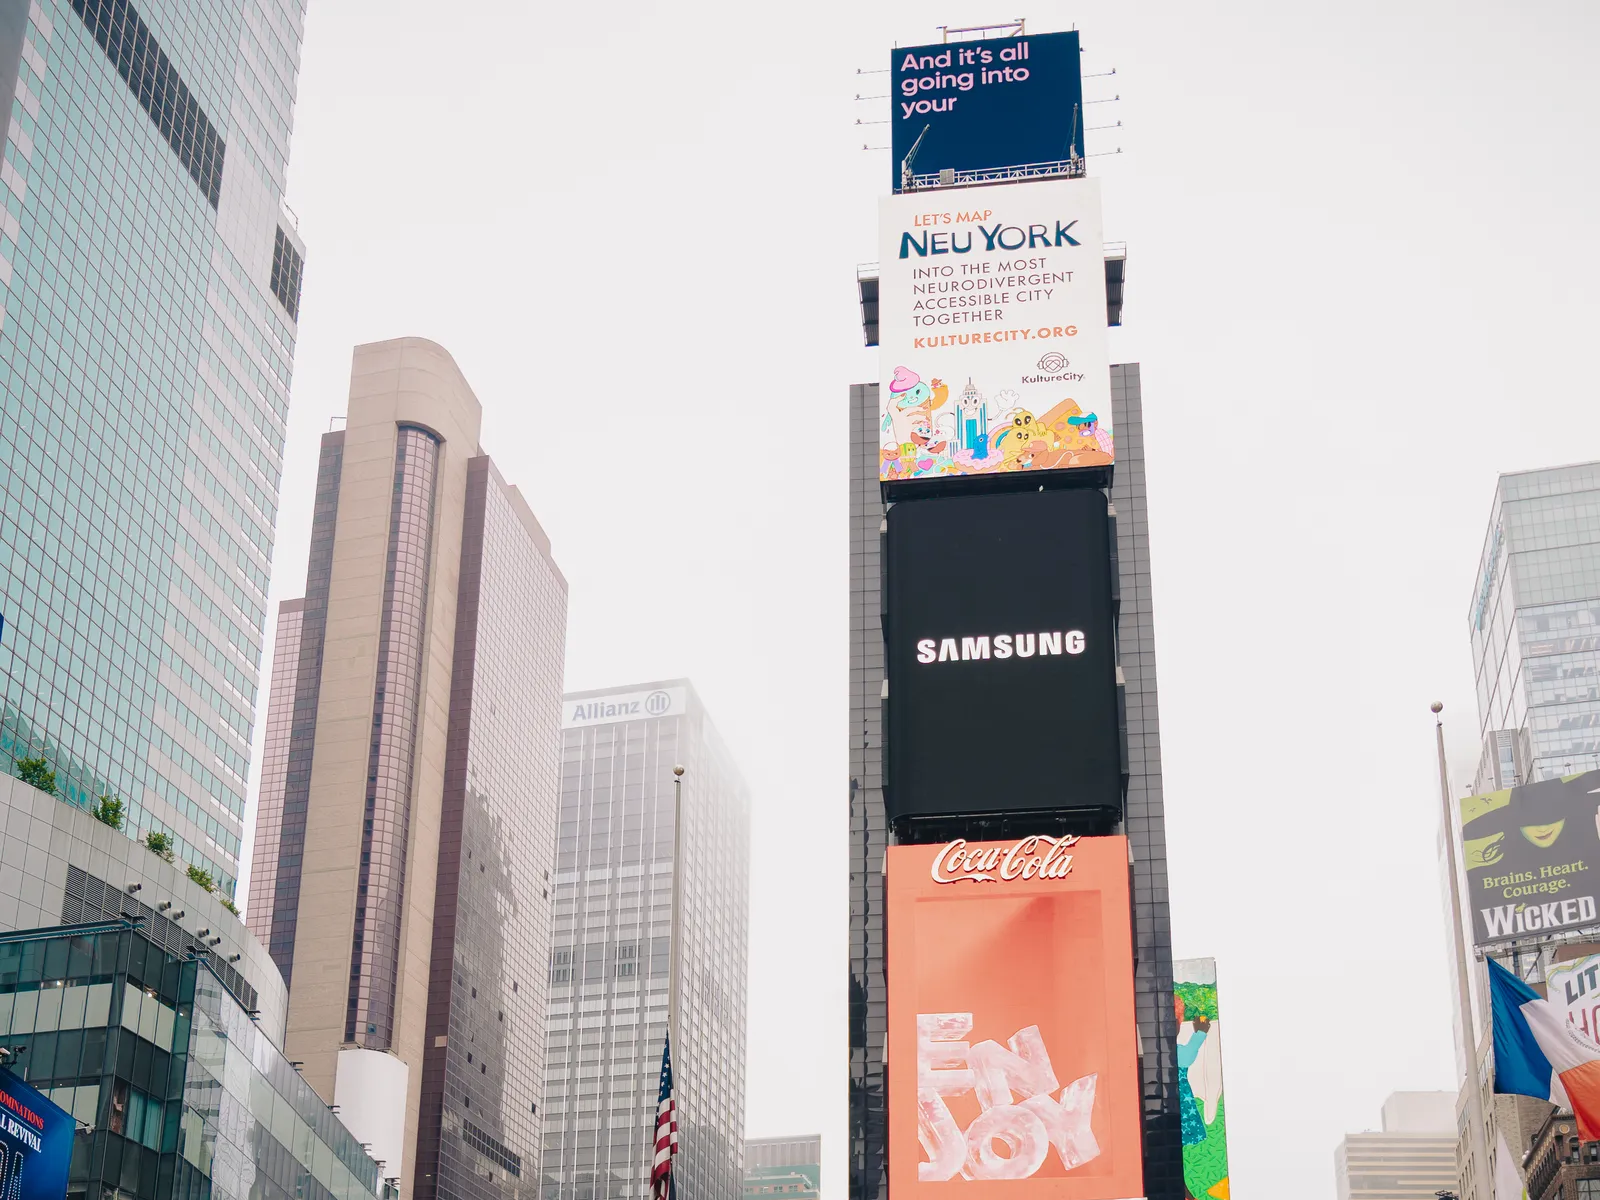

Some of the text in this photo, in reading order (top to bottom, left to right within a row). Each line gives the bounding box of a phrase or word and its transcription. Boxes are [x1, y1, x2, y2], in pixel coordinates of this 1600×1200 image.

[900, 42, 1029, 72] And it's all
[900, 65, 1030, 96] going into
[900, 96, 957, 119] your
[914, 210, 992, 227] LET'S MAP
[913, 258, 1047, 279] INTO THE MOST
[913, 271, 1074, 295] NEURODIVERGENT
[913, 288, 1054, 311] ACCESSIBLE CITY
[913, 309, 1004, 327] TOGETHER
[913, 324, 1078, 349] KULTURECITY.ORG
[1021, 372, 1085, 385] KultureCity
[916, 630, 1086, 664] SAMSUNG
[572, 700, 640, 721] Allianz
[930, 834, 1081, 884] Coca-Cola
[1482, 859, 1589, 890] Brains. Heart.
[1503, 877, 1571, 899] Courage.
[0, 1089, 44, 1130] OMINATIONS
[7, 1117, 42, 1153] REVIVAL
